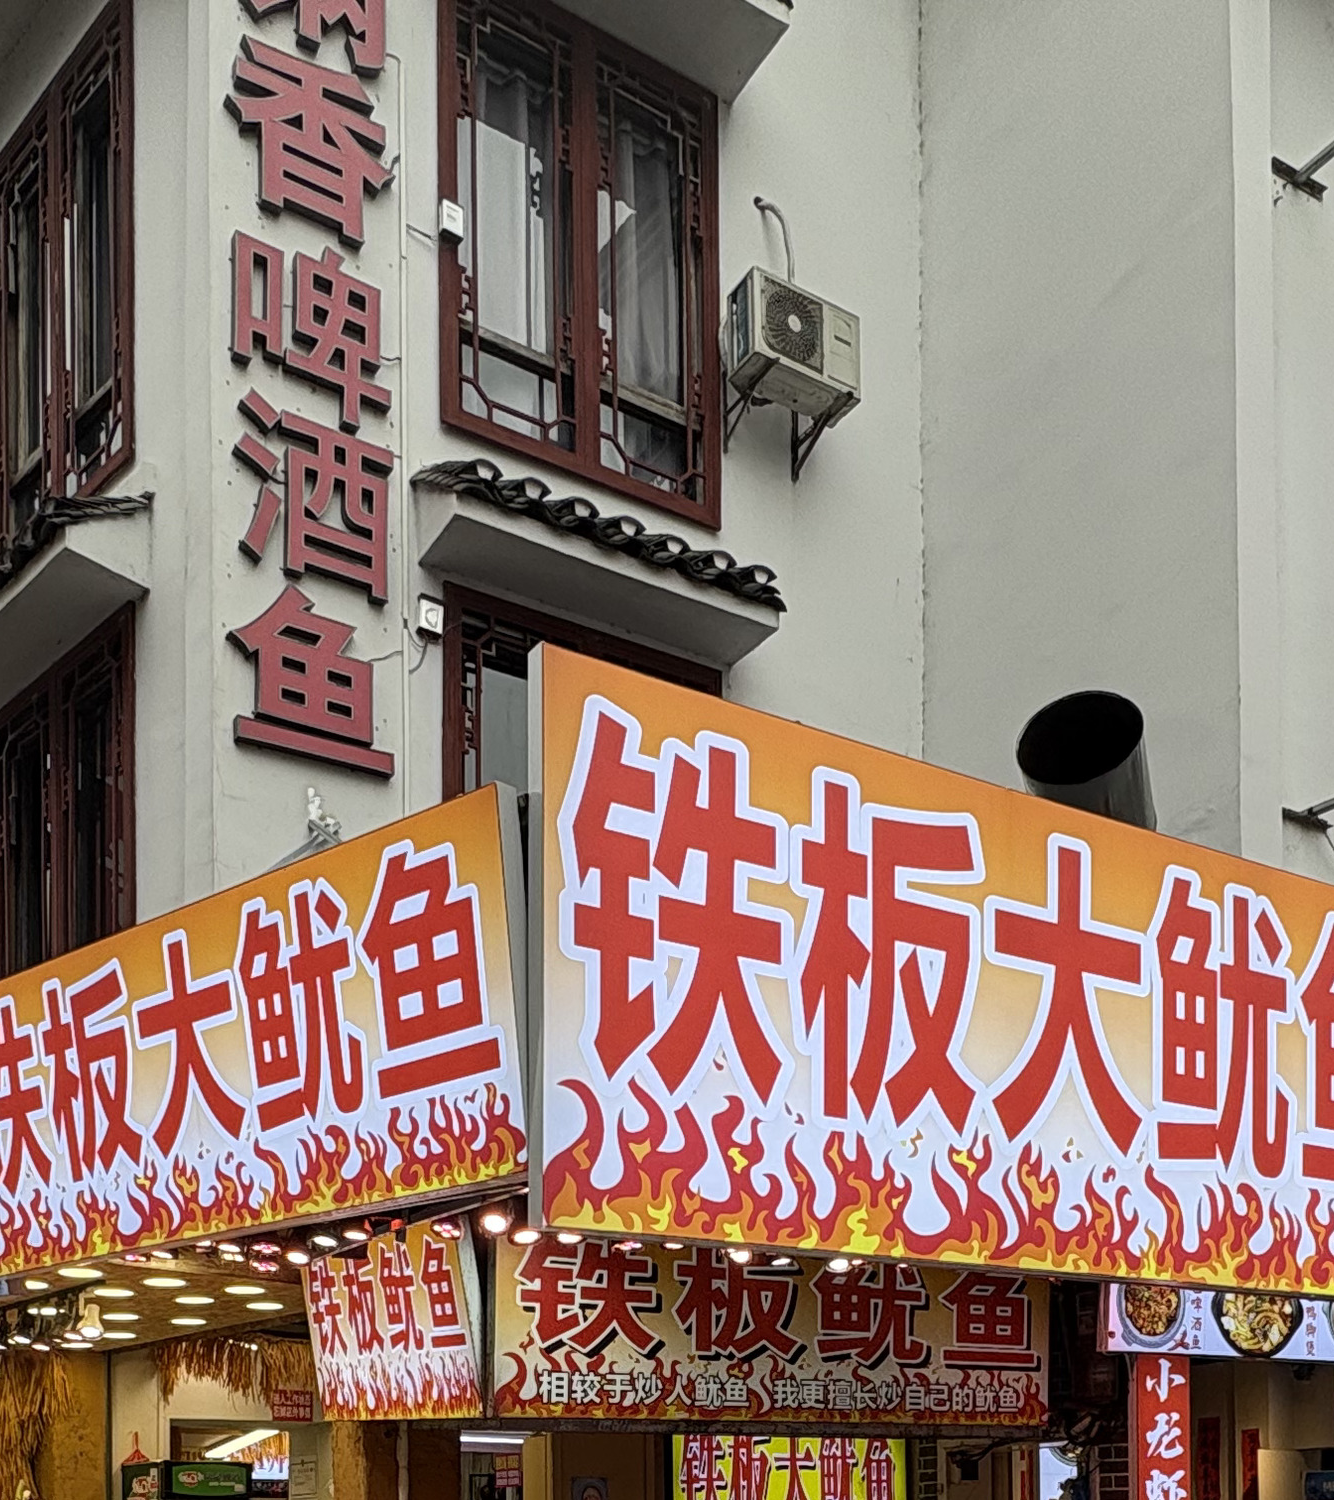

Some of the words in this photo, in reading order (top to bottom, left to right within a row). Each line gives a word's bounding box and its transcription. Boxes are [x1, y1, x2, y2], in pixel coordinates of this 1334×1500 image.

[310, 1236, 468, 1360] 铁板鱿鱼
[515, 1236, 1044, 1364] 铁板鱿鱼
[1190, 1289, 1203, 1351] 啤酒鱼
[539, 1368, 750, 1409] 相较于炒人鱿鱼
[772, 1376, 1021, 1414] 我更擅长炒自己的鱿鱼
